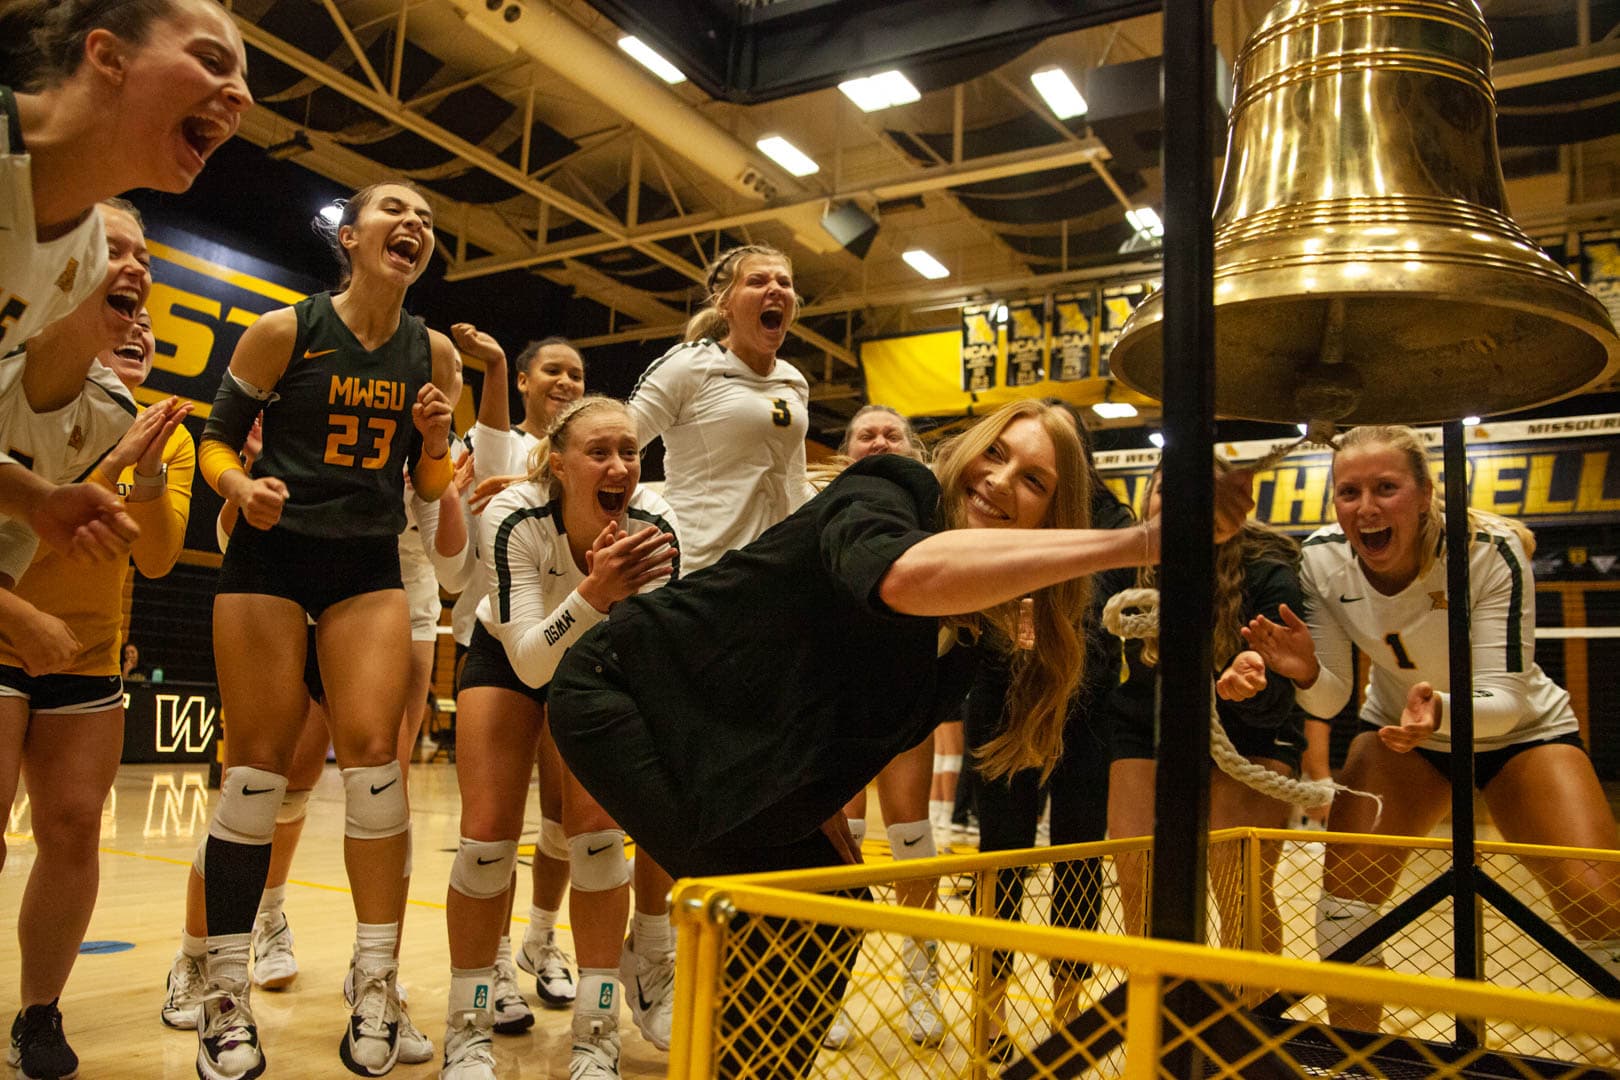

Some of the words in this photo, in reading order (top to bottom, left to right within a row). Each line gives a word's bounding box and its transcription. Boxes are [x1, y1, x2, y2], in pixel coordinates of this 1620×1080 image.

[328, 374, 407, 412] MWSU
[323, 413, 398, 470] 23
[544, 609, 577, 647] MWSU
[1385, 632, 1416, 670] 1
